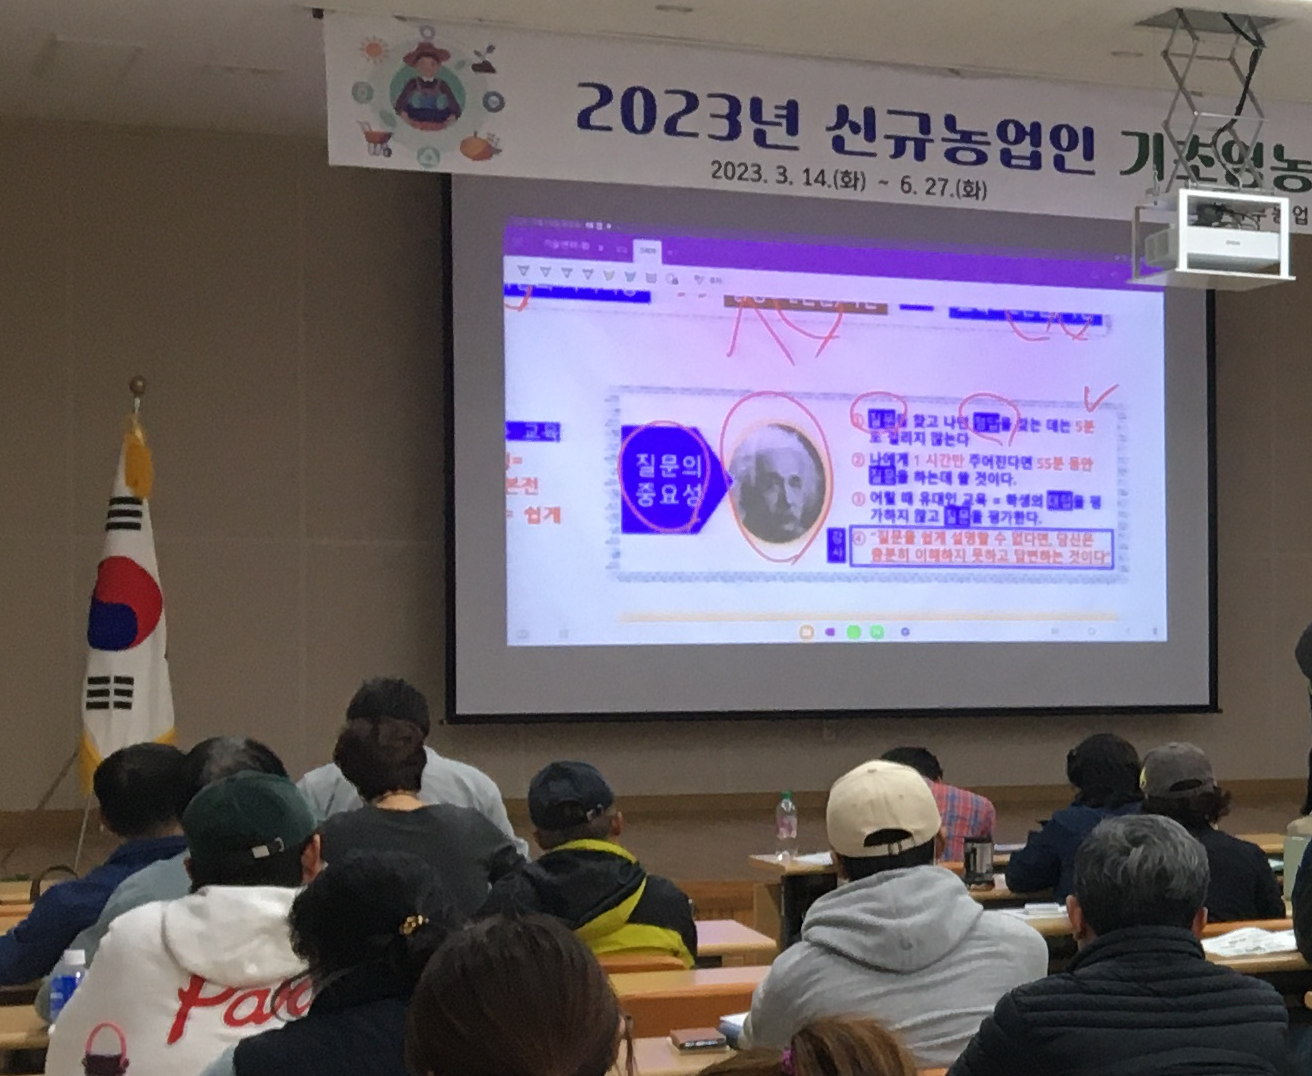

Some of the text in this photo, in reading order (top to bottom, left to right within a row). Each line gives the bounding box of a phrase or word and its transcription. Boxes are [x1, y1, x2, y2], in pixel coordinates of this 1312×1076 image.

[576, 81, 801, 152] 2023년
[825, 103, 1096, 177] 신규농업인
[711, 160, 768, 184] 2023.
[775, 165, 794, 186] 3.
[802, 168, 866, 192] 14.(화)
[900, 175, 917, 195] 6.
[925, 177, 988, 202] 27.(화)
[635, 453, 702, 478] 질문의
[870, 451, 909, 467] 나에게
[926, 453, 965, 468] 시간만
[969, 453, 1033, 470] 주어진다면
[1037, 456, 1064, 471] 55분
[635, 482, 703, 507] 중요성
[995, 532, 1006, 546] 수
[1057, 532, 1094, 547] 당신은
[915, 548, 966, 563] 이해하지
